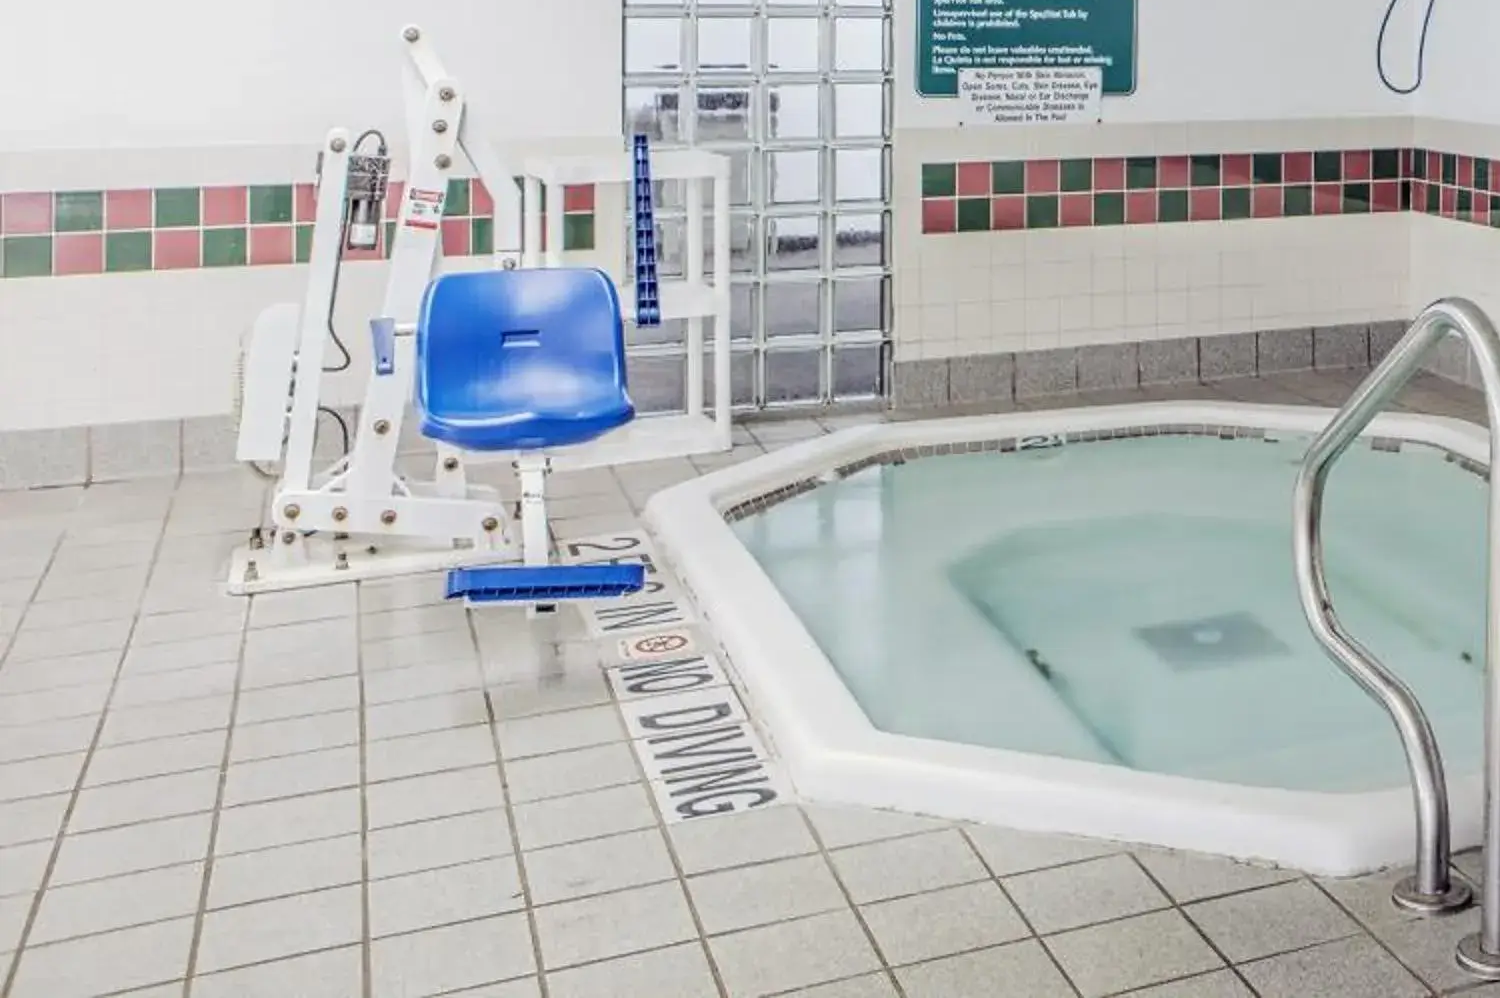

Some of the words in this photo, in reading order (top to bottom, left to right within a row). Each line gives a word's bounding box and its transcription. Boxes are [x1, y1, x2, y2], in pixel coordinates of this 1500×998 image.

[568, 537, 641, 557] 2
[594, 601, 684, 632] IN
[619, 656, 714, 694] NO
[638, 701, 778, 820] DIVING
